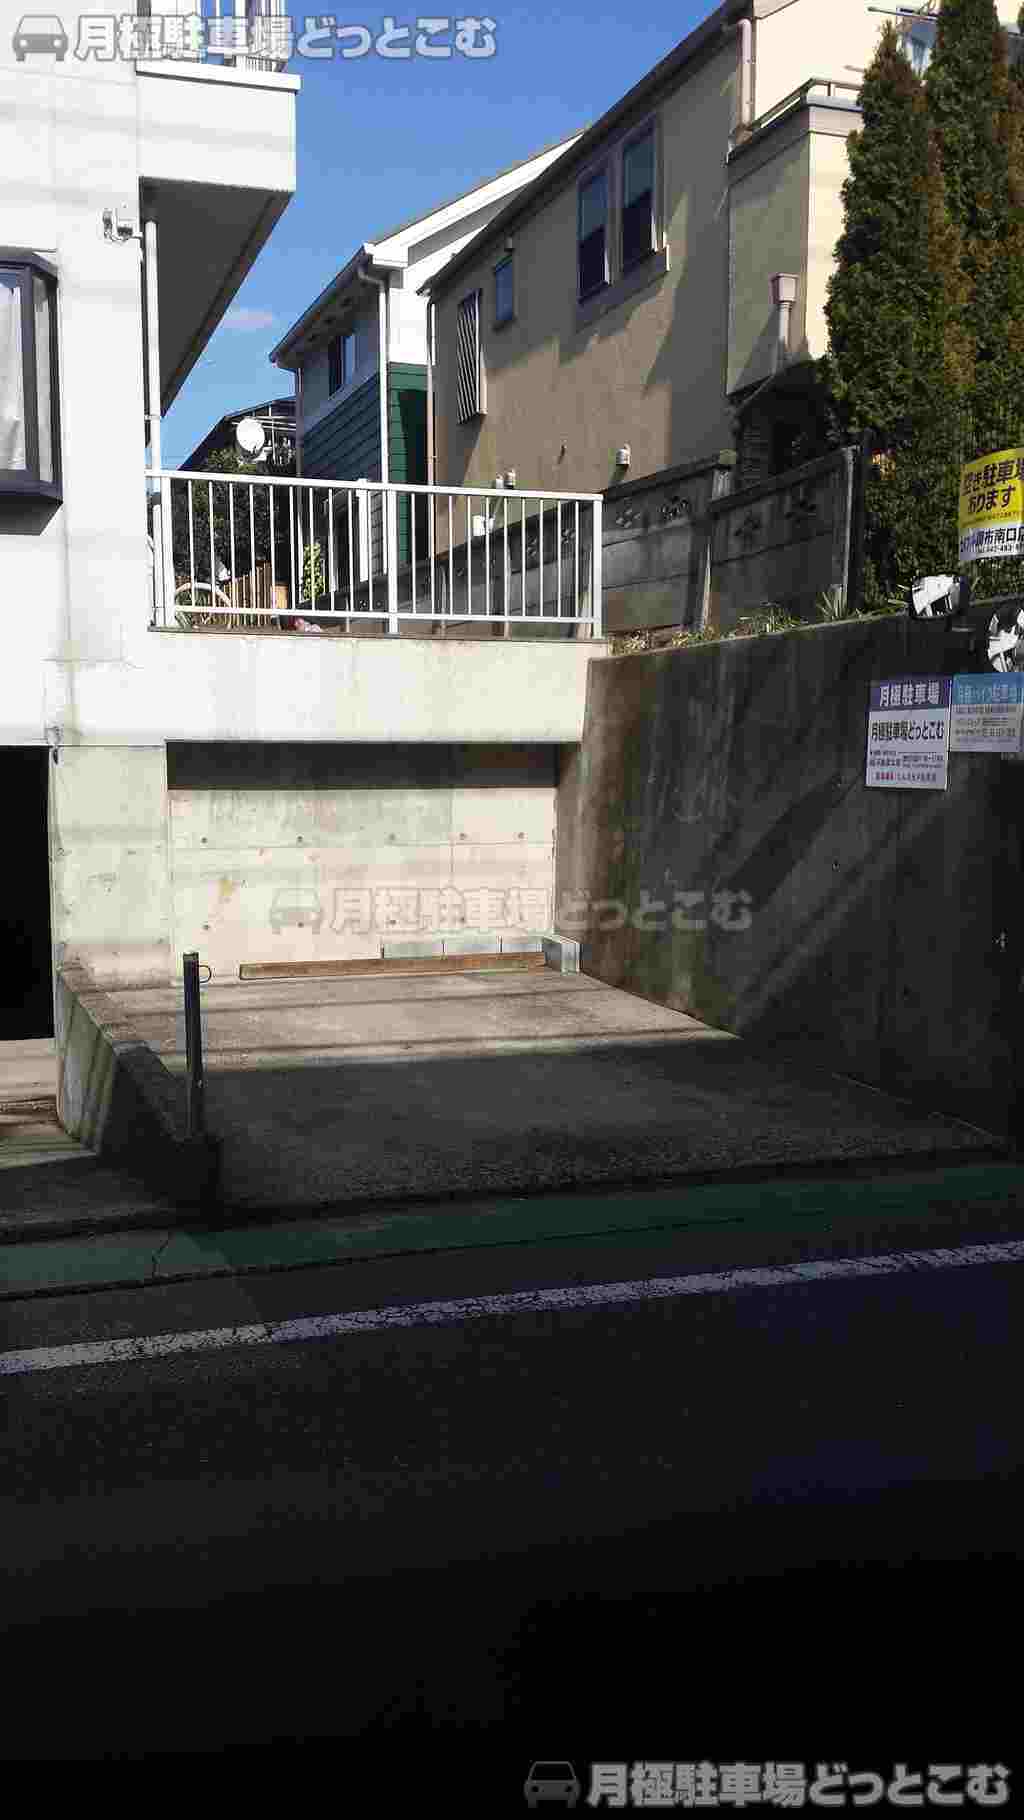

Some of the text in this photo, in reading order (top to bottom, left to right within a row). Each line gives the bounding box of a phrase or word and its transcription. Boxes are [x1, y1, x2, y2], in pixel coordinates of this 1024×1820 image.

[880, 680, 940, 706] 月極駐車場
[871, 719, 945, 741] 月極駐車場どっとこむ
